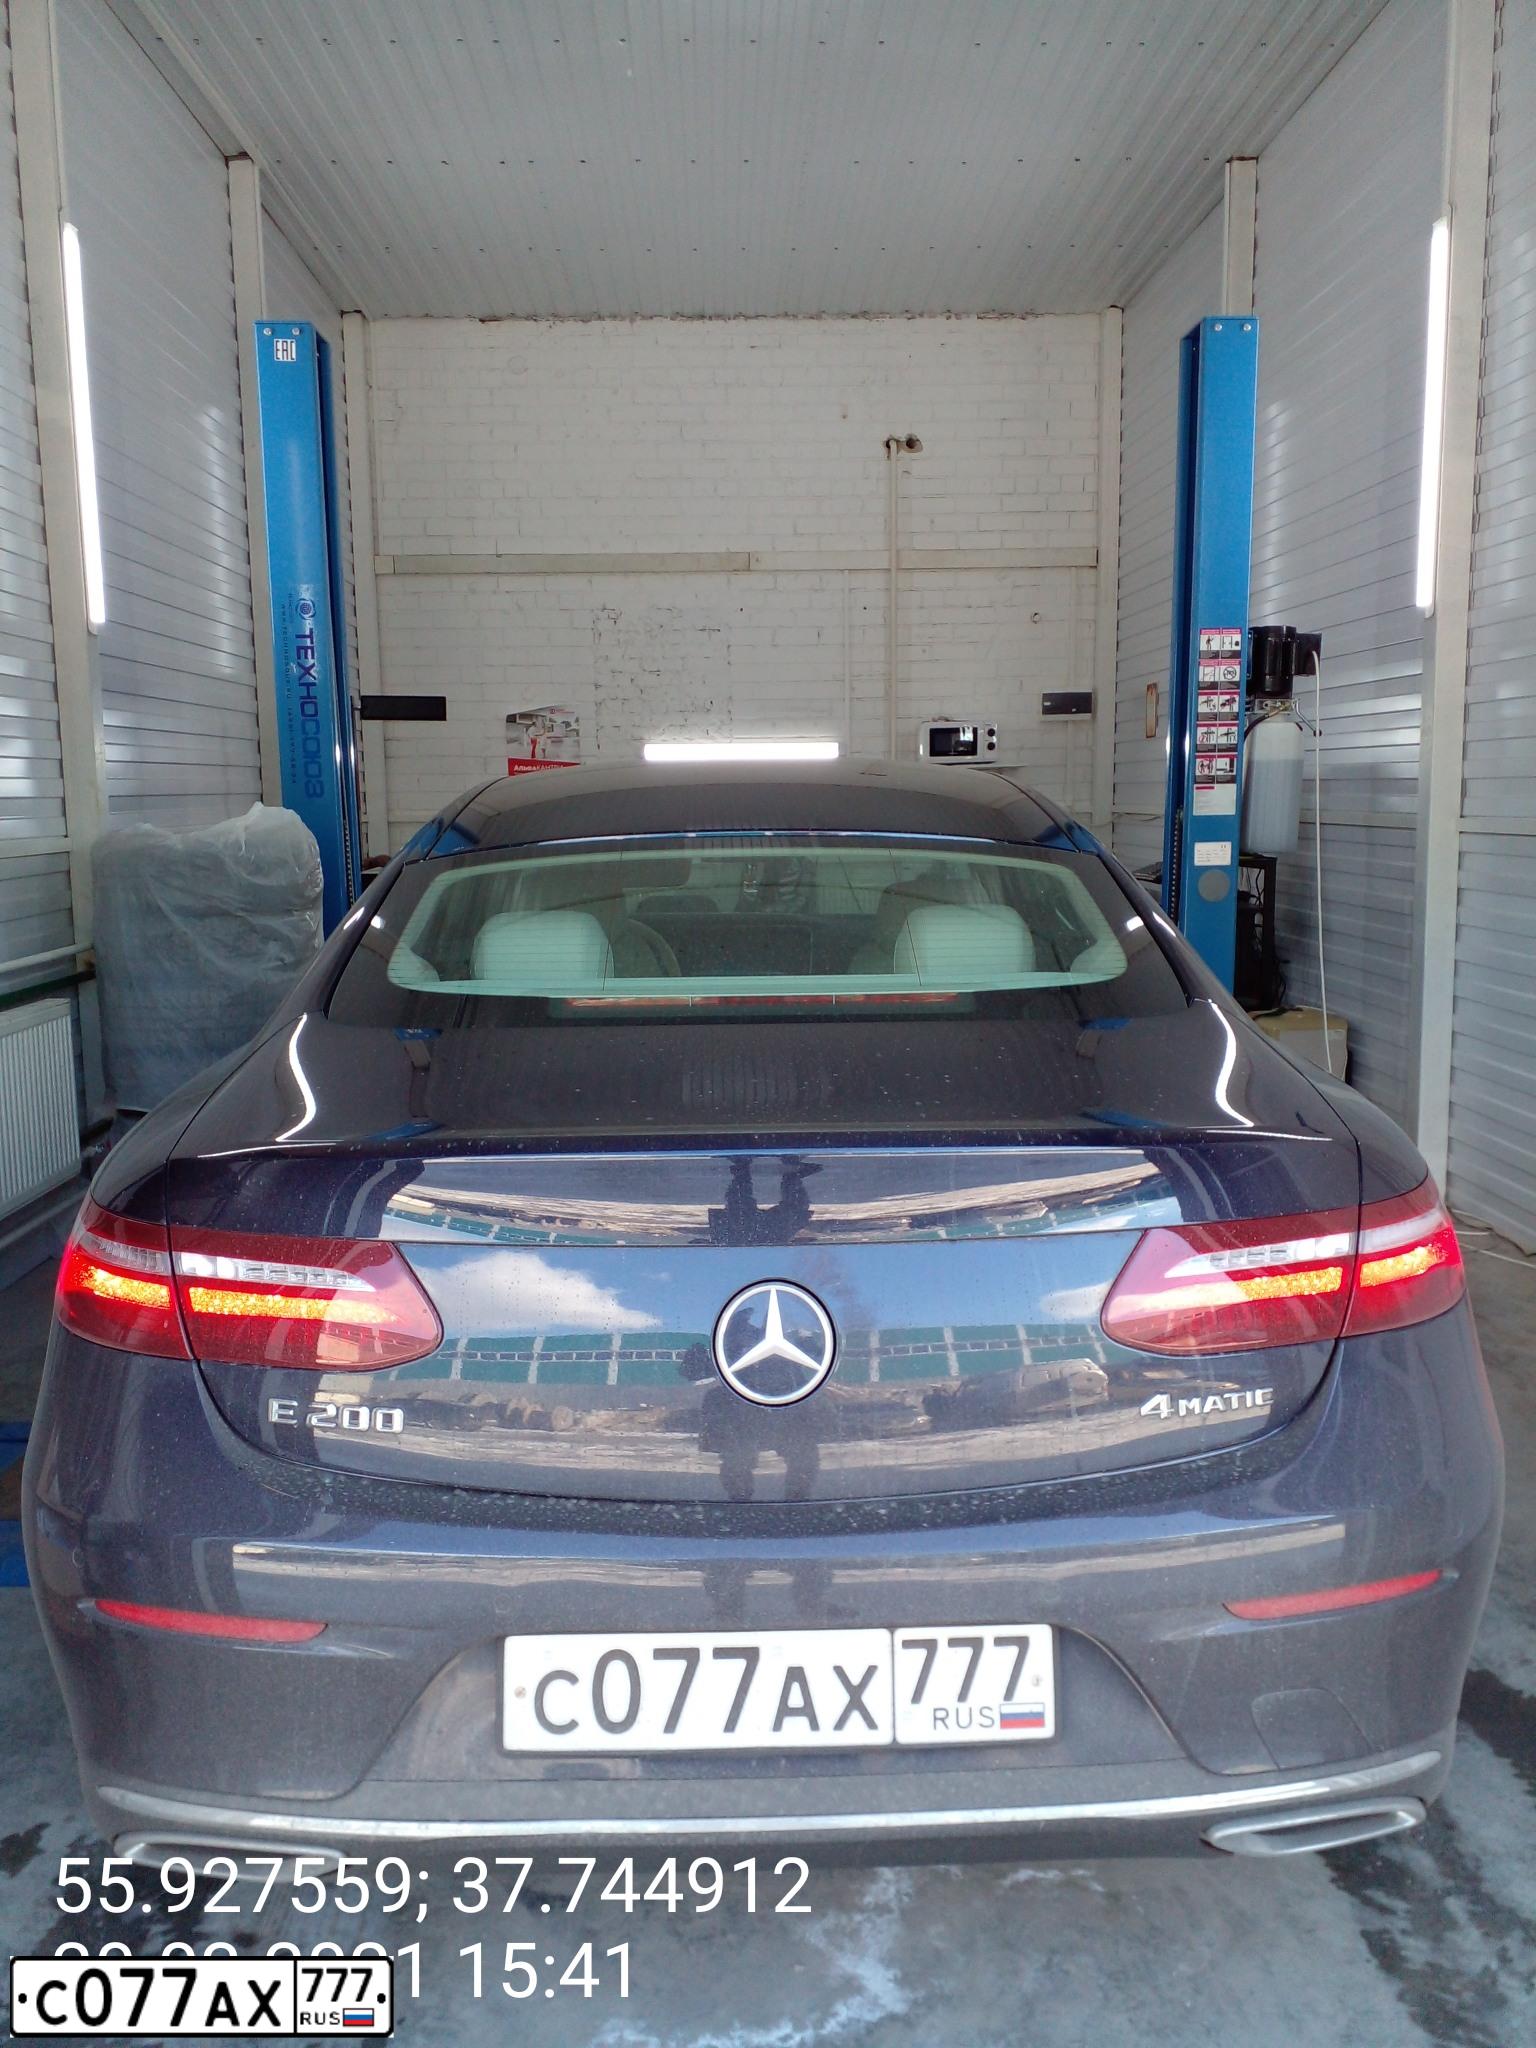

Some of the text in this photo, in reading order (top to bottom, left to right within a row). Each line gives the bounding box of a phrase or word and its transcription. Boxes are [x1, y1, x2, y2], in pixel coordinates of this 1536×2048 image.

[295, 627, 325, 799] ТЕХНОСОЮЗ
[268, 1398, 404, 1433] E 200
[901, 1636, 1030, 1704] 777
[933, 1706, 996, 1731] RUS
